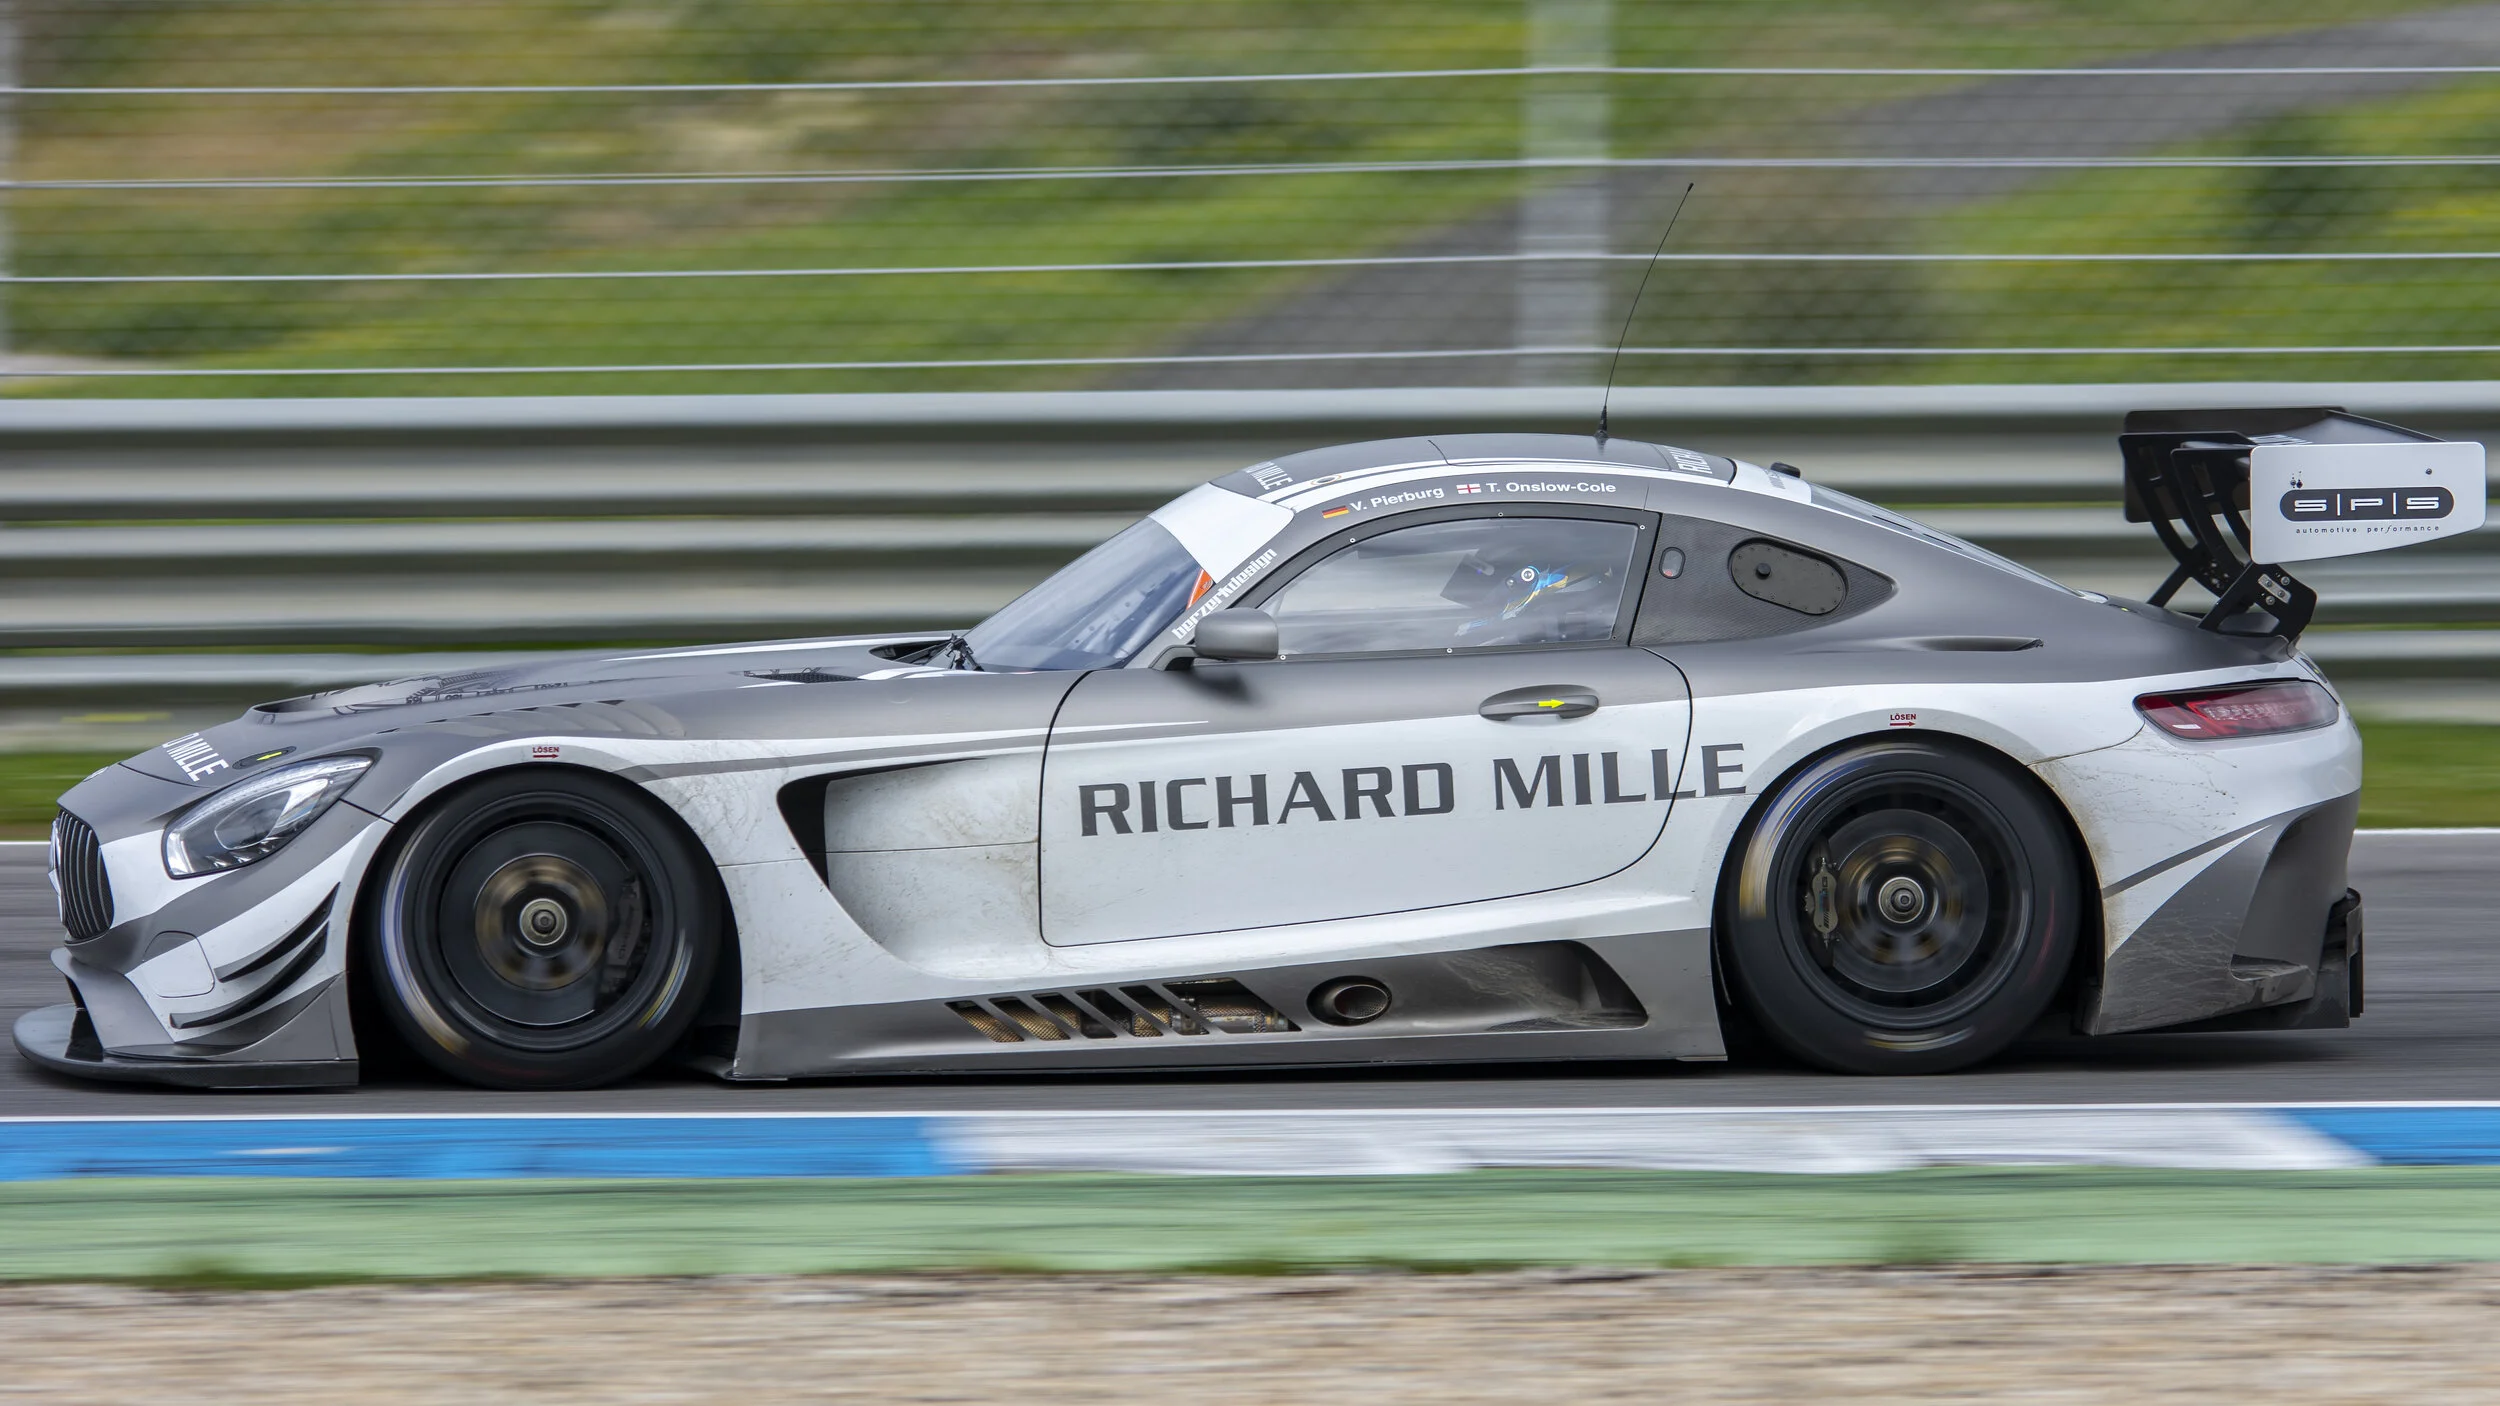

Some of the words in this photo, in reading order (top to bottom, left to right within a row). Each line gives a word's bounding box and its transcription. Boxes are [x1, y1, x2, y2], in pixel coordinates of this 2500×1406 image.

[1486, 483, 1500, 493] T.
[1505, 481, 1617, 493] Onslow-Cole
[1350, 501, 1368, 512] V.
[1371, 486, 1445, 508] Pierburg
[2295, 526, 2358, 534] automotive
[2367, 524, 2440, 534] performance
[1171, 548, 1278, 640] berzerkdesign
[1890, 713, 1917, 721] LÖSEN
[532, 745, 560, 753] LÖSEN
[166, 737, 230, 782] MILLE
[1079, 762, 1455, 837] RICHARD
[1492, 743, 1747, 811] MILLE
